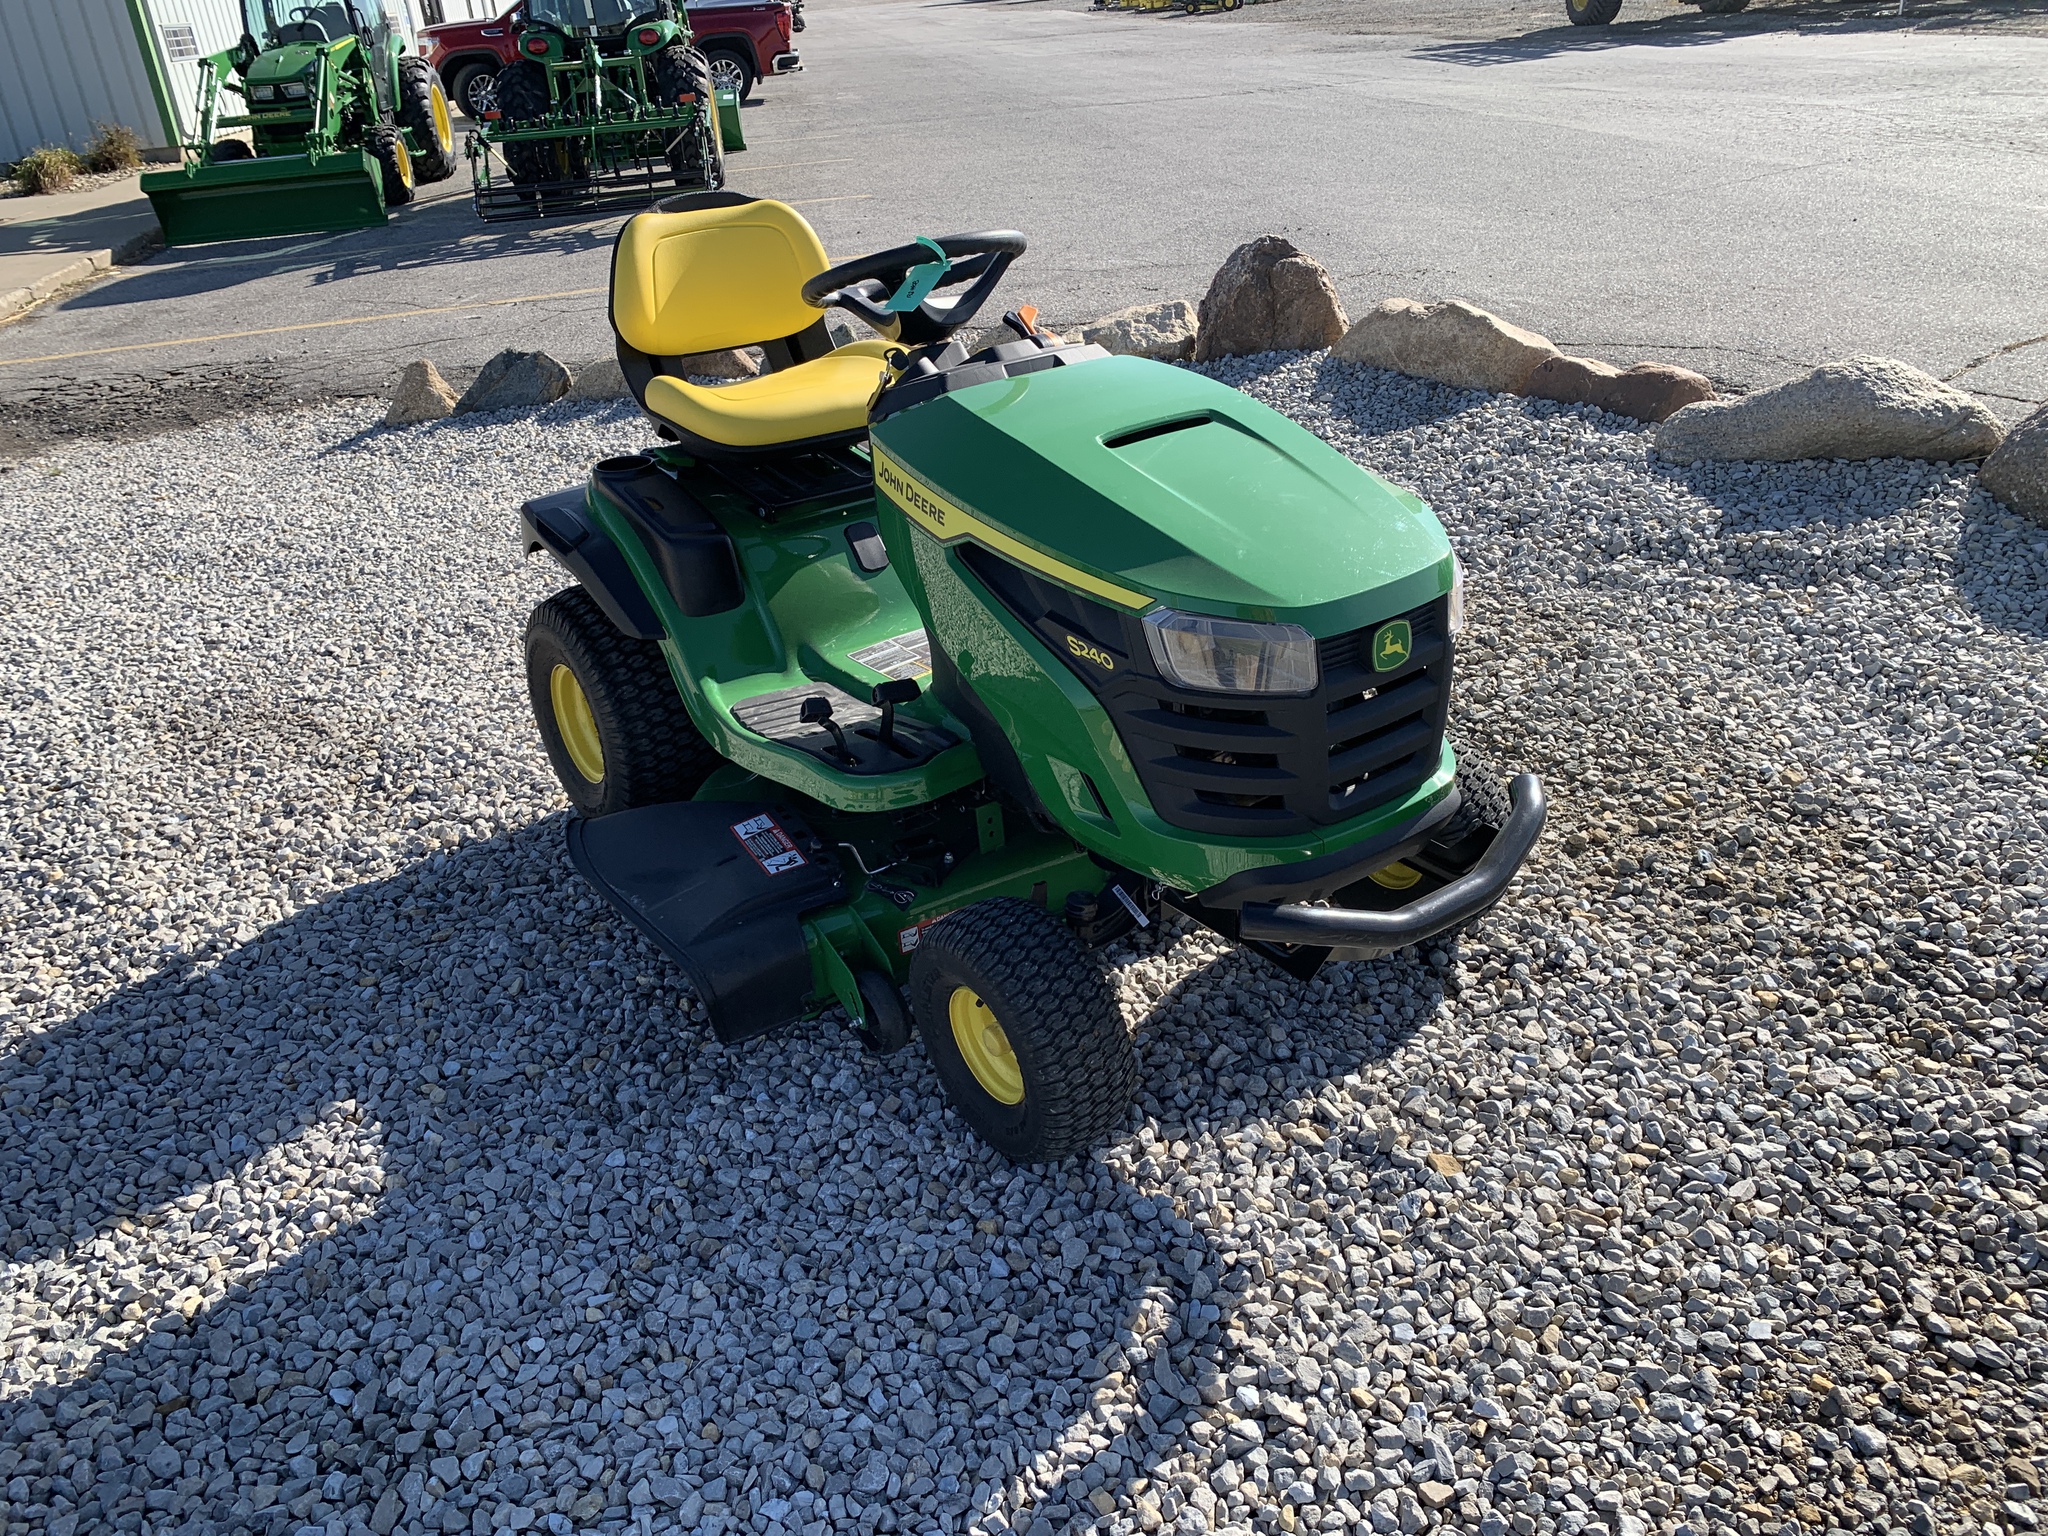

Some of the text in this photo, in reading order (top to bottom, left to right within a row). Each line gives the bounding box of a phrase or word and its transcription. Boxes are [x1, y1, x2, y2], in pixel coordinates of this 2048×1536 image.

[238, 110, 292, 121] JOHN DEERE
[878, 461, 946, 528] JOHN DEERE
[1066, 635, 1114, 670] S240
[776, 831, 794, 848] DANGER
